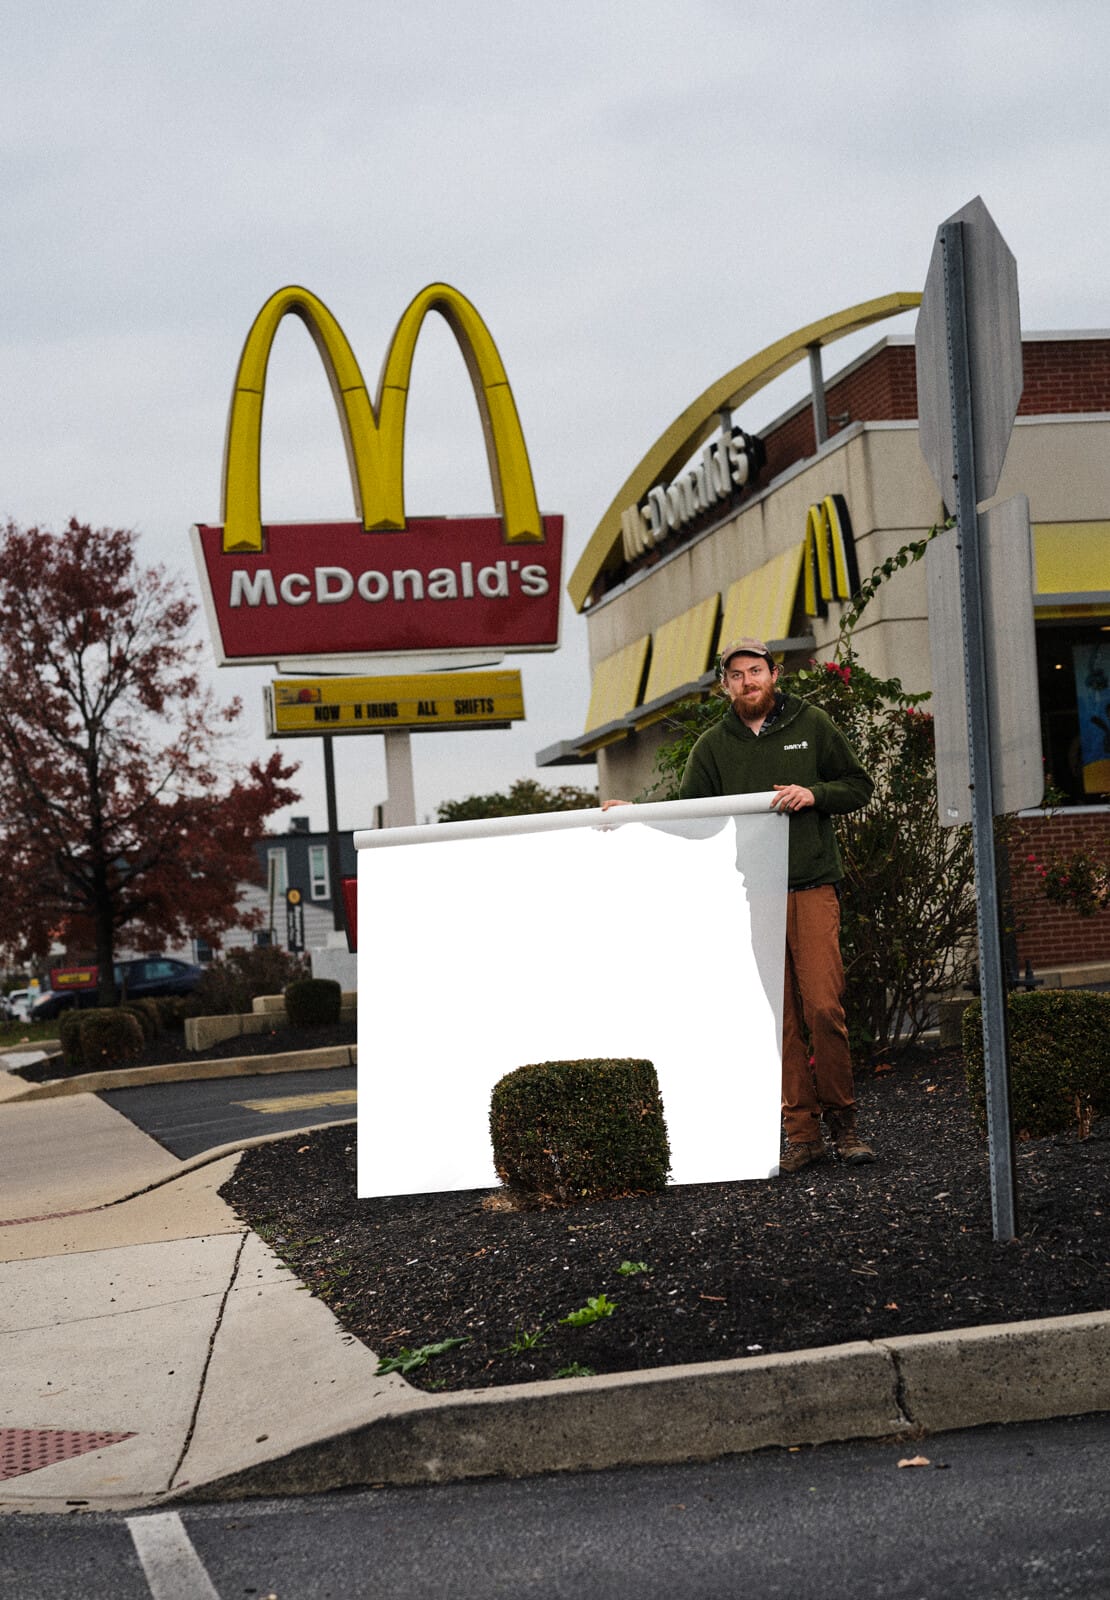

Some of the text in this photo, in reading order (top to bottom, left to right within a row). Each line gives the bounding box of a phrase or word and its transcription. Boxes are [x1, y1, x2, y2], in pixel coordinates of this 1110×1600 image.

[229, 560, 550, 608] McDonald's
[314, 704, 340, 721] NOW
[417, 700, 438, 716] ALL
[454, 698, 494, 715] SHIFTS
